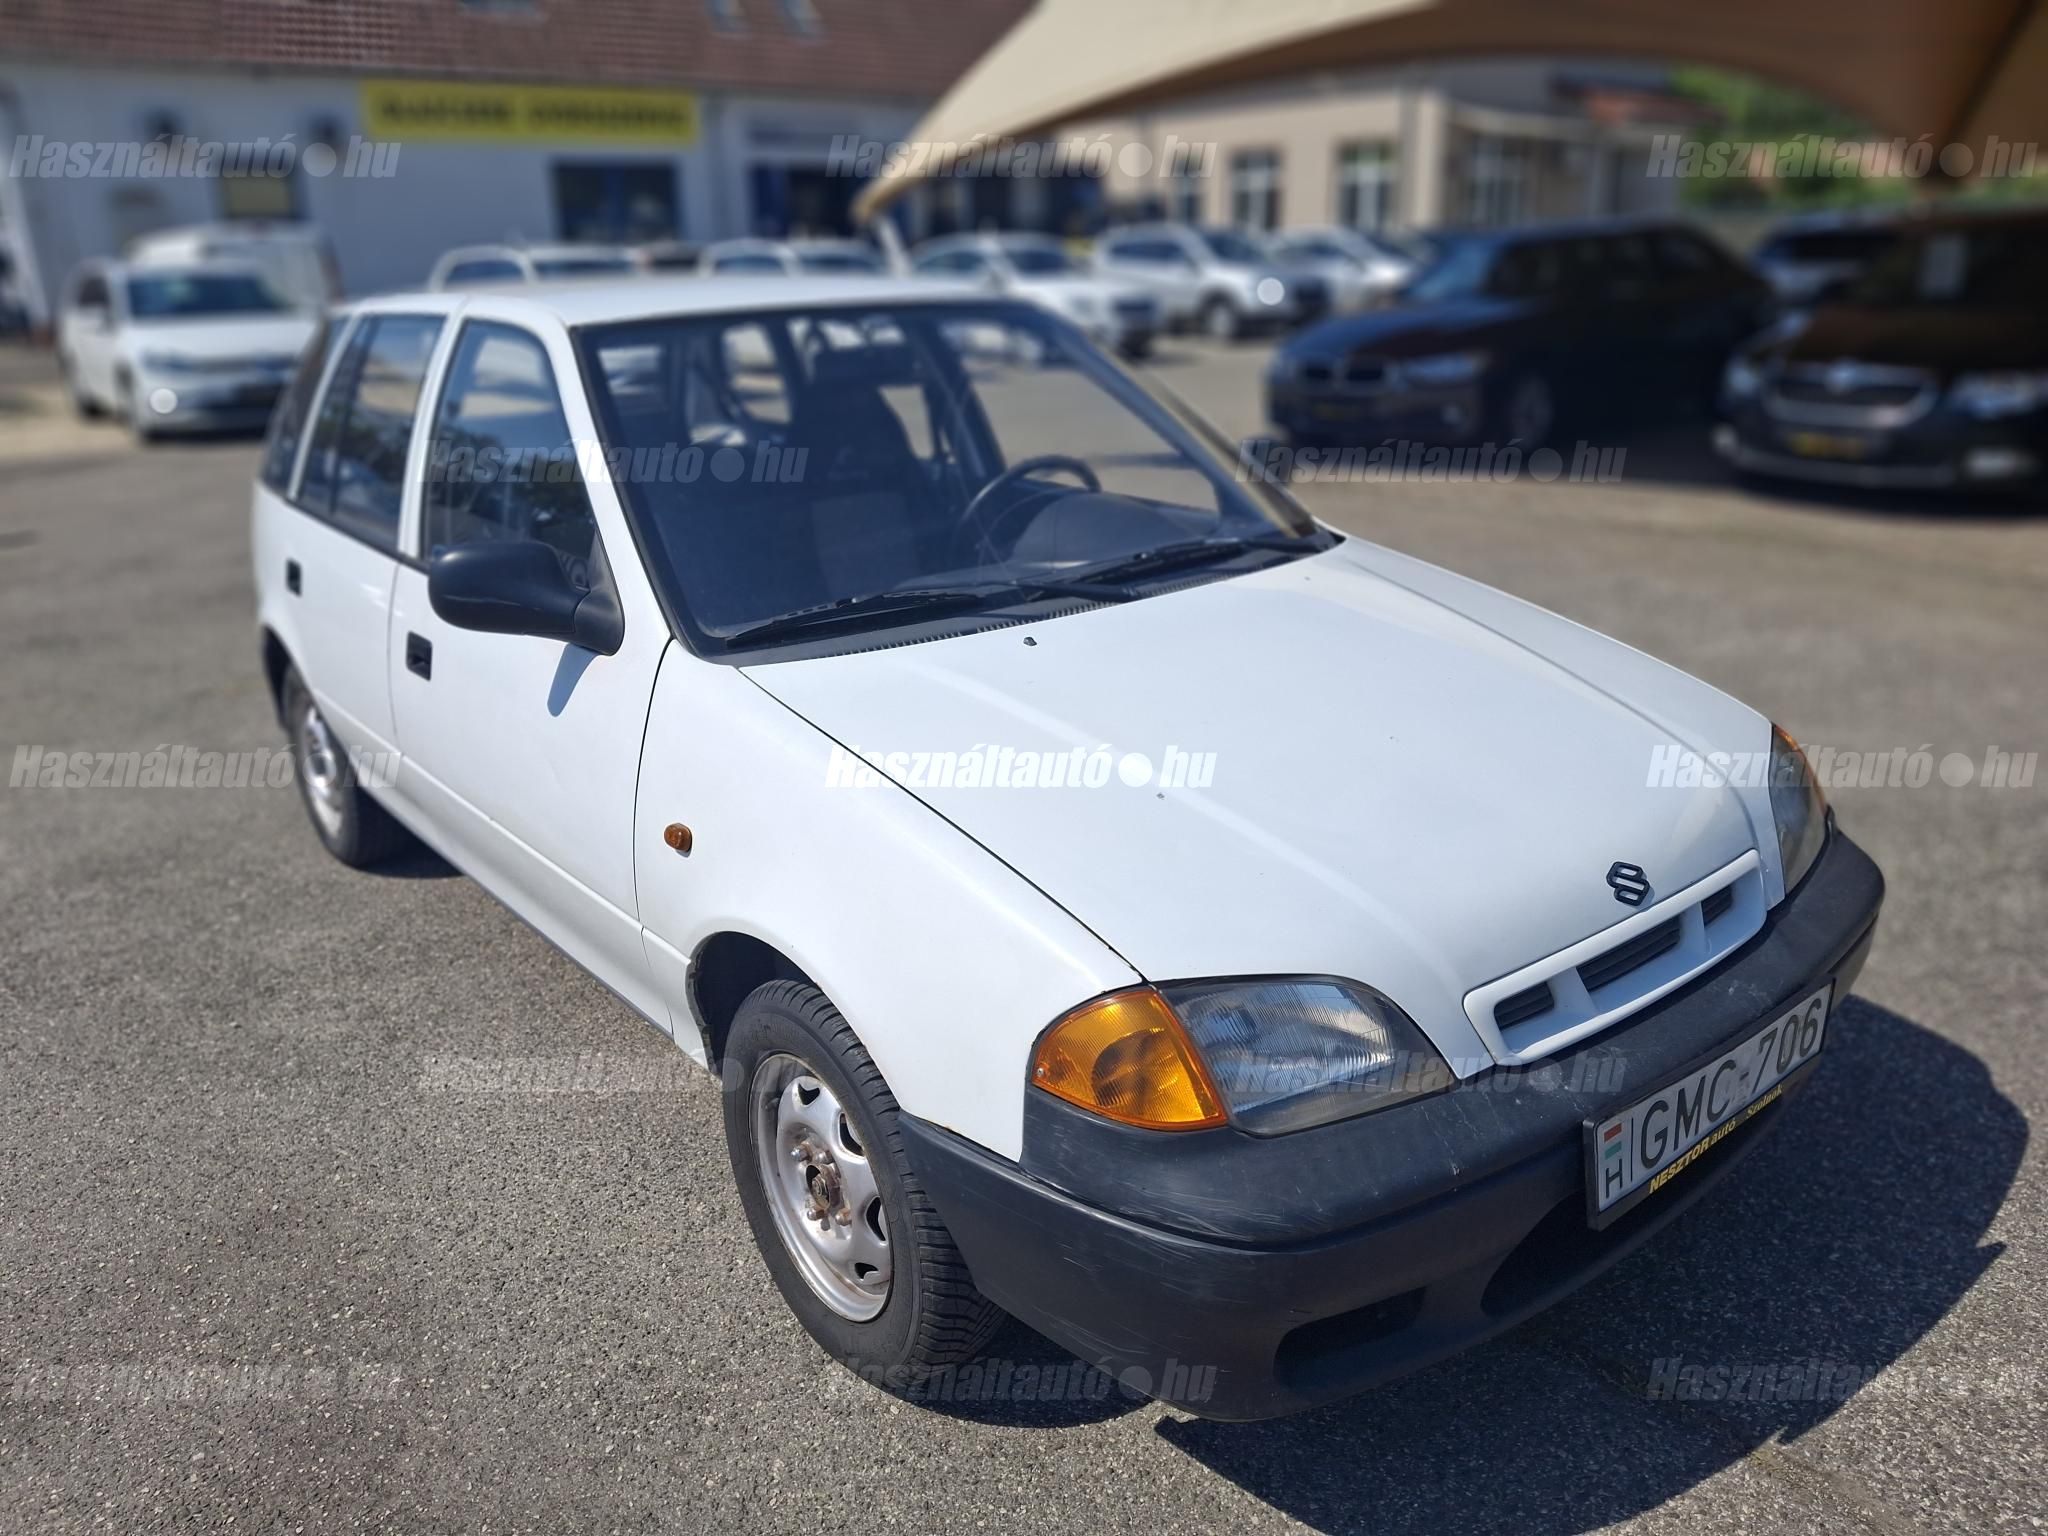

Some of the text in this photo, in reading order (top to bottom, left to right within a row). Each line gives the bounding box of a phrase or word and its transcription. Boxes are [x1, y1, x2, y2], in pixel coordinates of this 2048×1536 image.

[1640, 998, 1822, 1169] GMC-706
[1649, 1137, 1710, 1194] NESZTOR
[1711, 1118, 1737, 1145] autó
